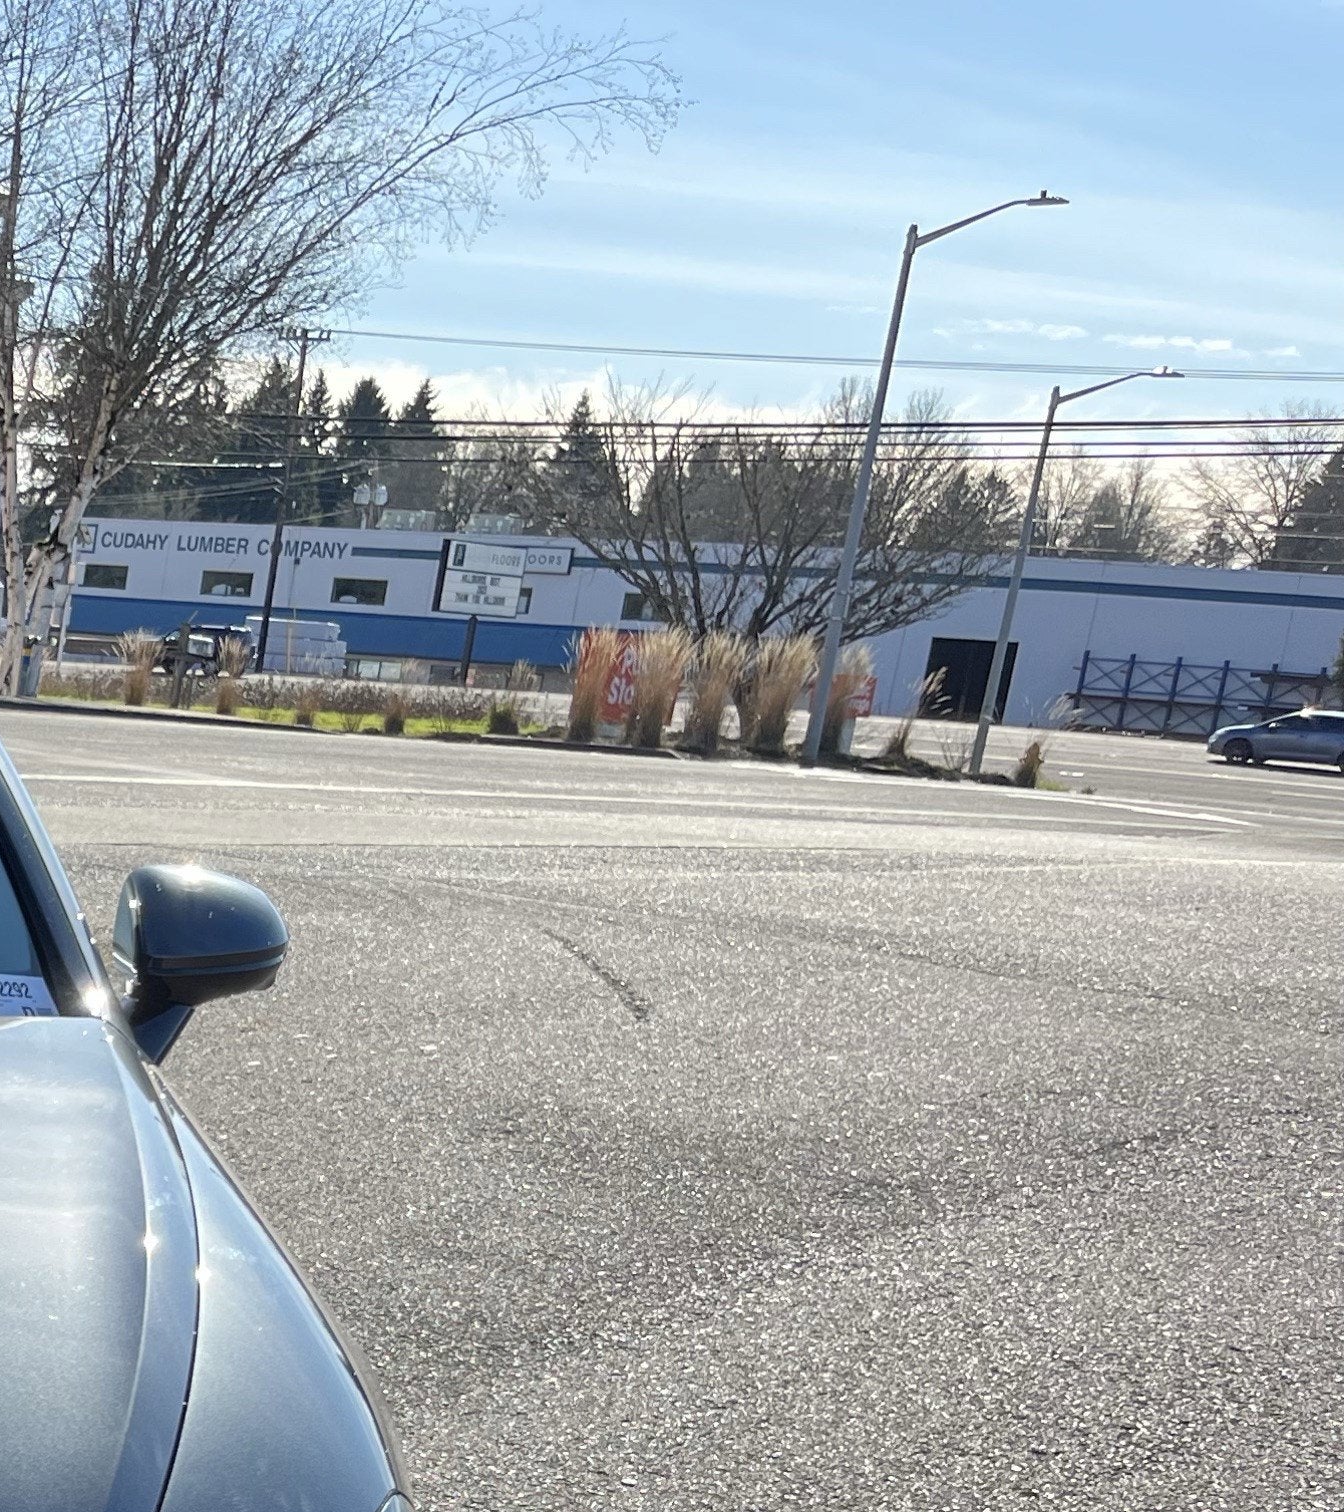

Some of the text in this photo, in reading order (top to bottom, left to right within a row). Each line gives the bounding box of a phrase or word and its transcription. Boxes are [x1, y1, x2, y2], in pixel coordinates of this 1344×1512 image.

[101, 531, 349, 560] CUDAHY LUMBER CMPANY
